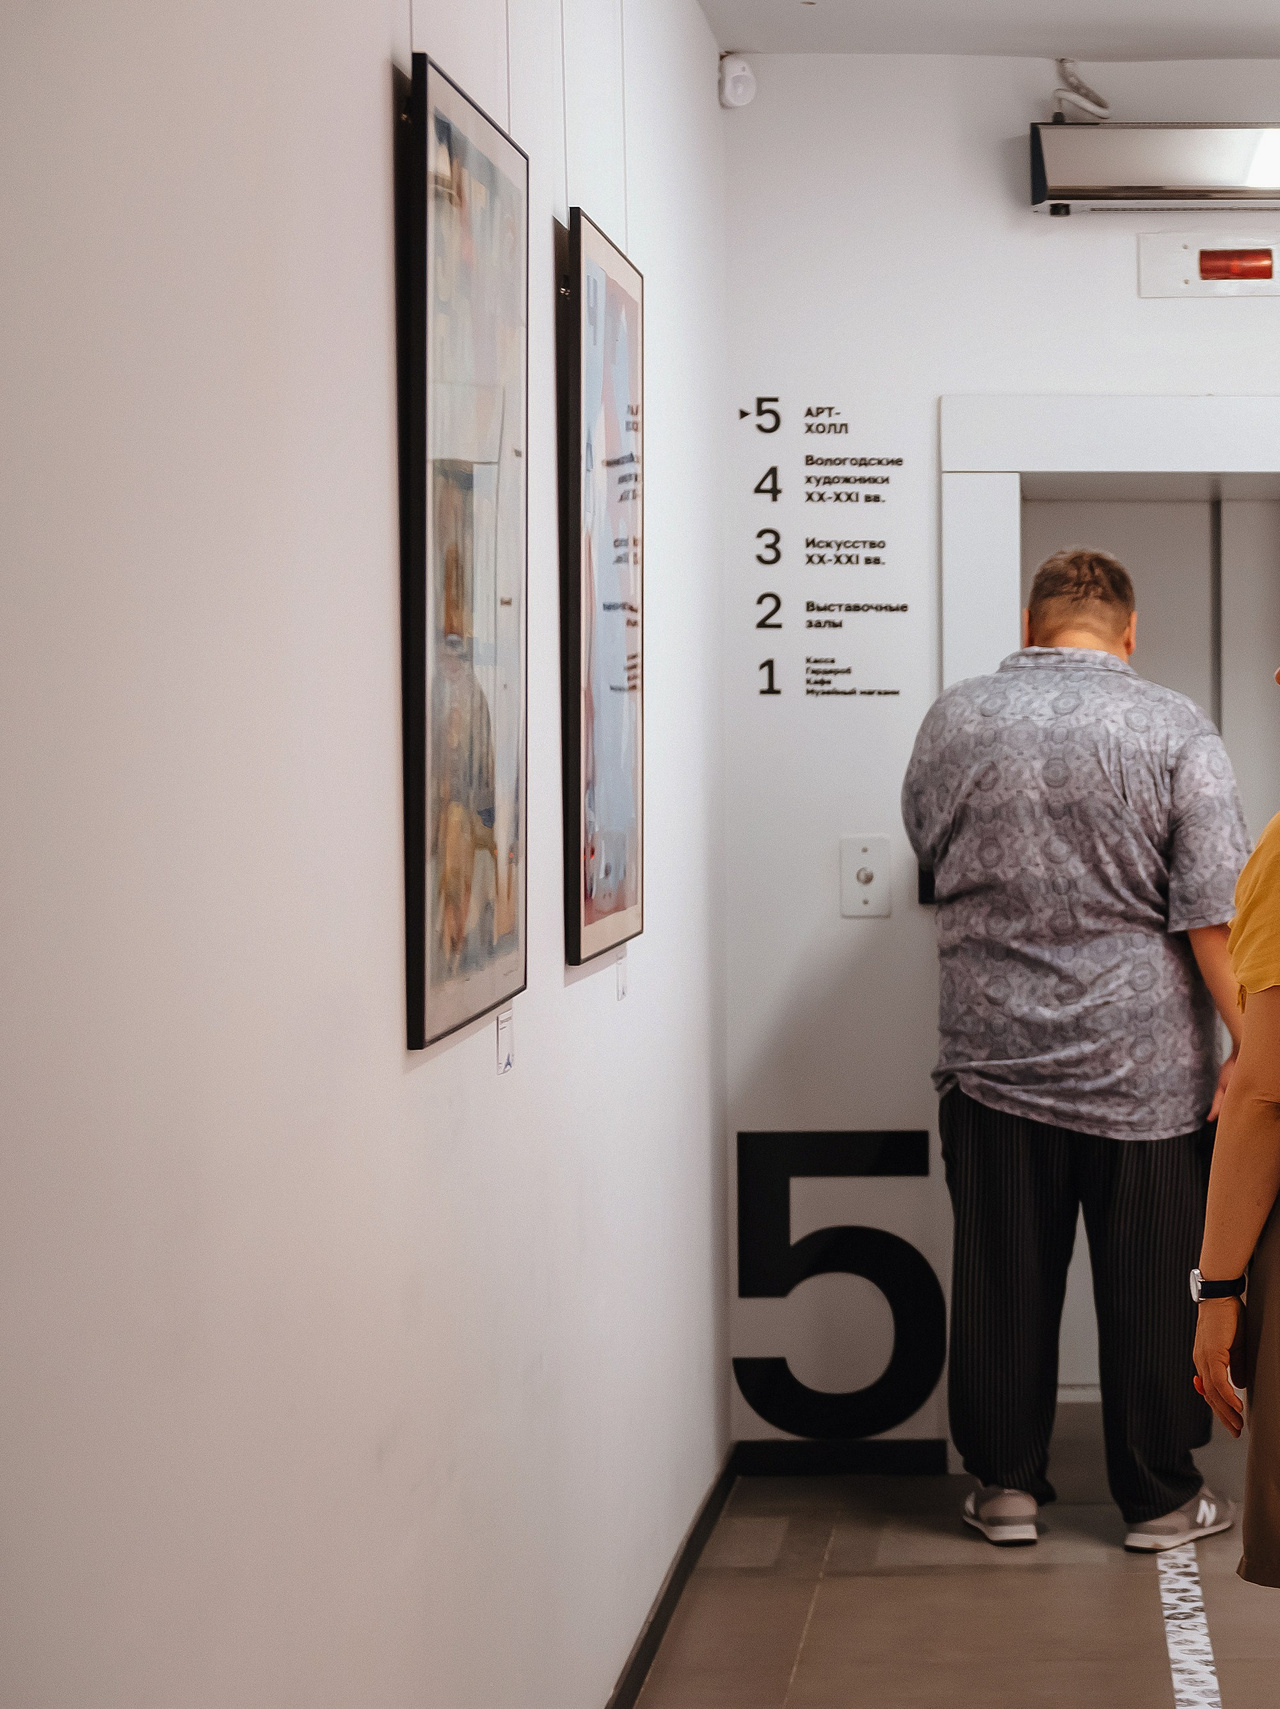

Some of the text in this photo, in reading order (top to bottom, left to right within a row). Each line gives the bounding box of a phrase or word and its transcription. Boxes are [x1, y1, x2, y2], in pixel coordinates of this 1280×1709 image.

[755, 396, 782, 434] 5
[803, 406, 841, 418] АРТ-
[804, 422, 849, 434] ХОЛЛ
[804, 454, 904, 467] Вологодские
[753, 465, 783, 502] 4
[804, 475, 890, 487] художники
[863, 493, 886, 503] вв.
[755, 527, 782, 566] 3
[804, 537, 887, 551] Искусство
[863, 555, 886, 566] вв.
[755, 591, 783, 629] 2
[804, 600, 909, 613] Выставочные
[804, 619, 843, 629] залы
[805, 656, 836, 664] Касса
[758, 658, 782, 695] 1
[805, 678, 832, 686] Кафе
[732, 1130, 947, 1440] 5
